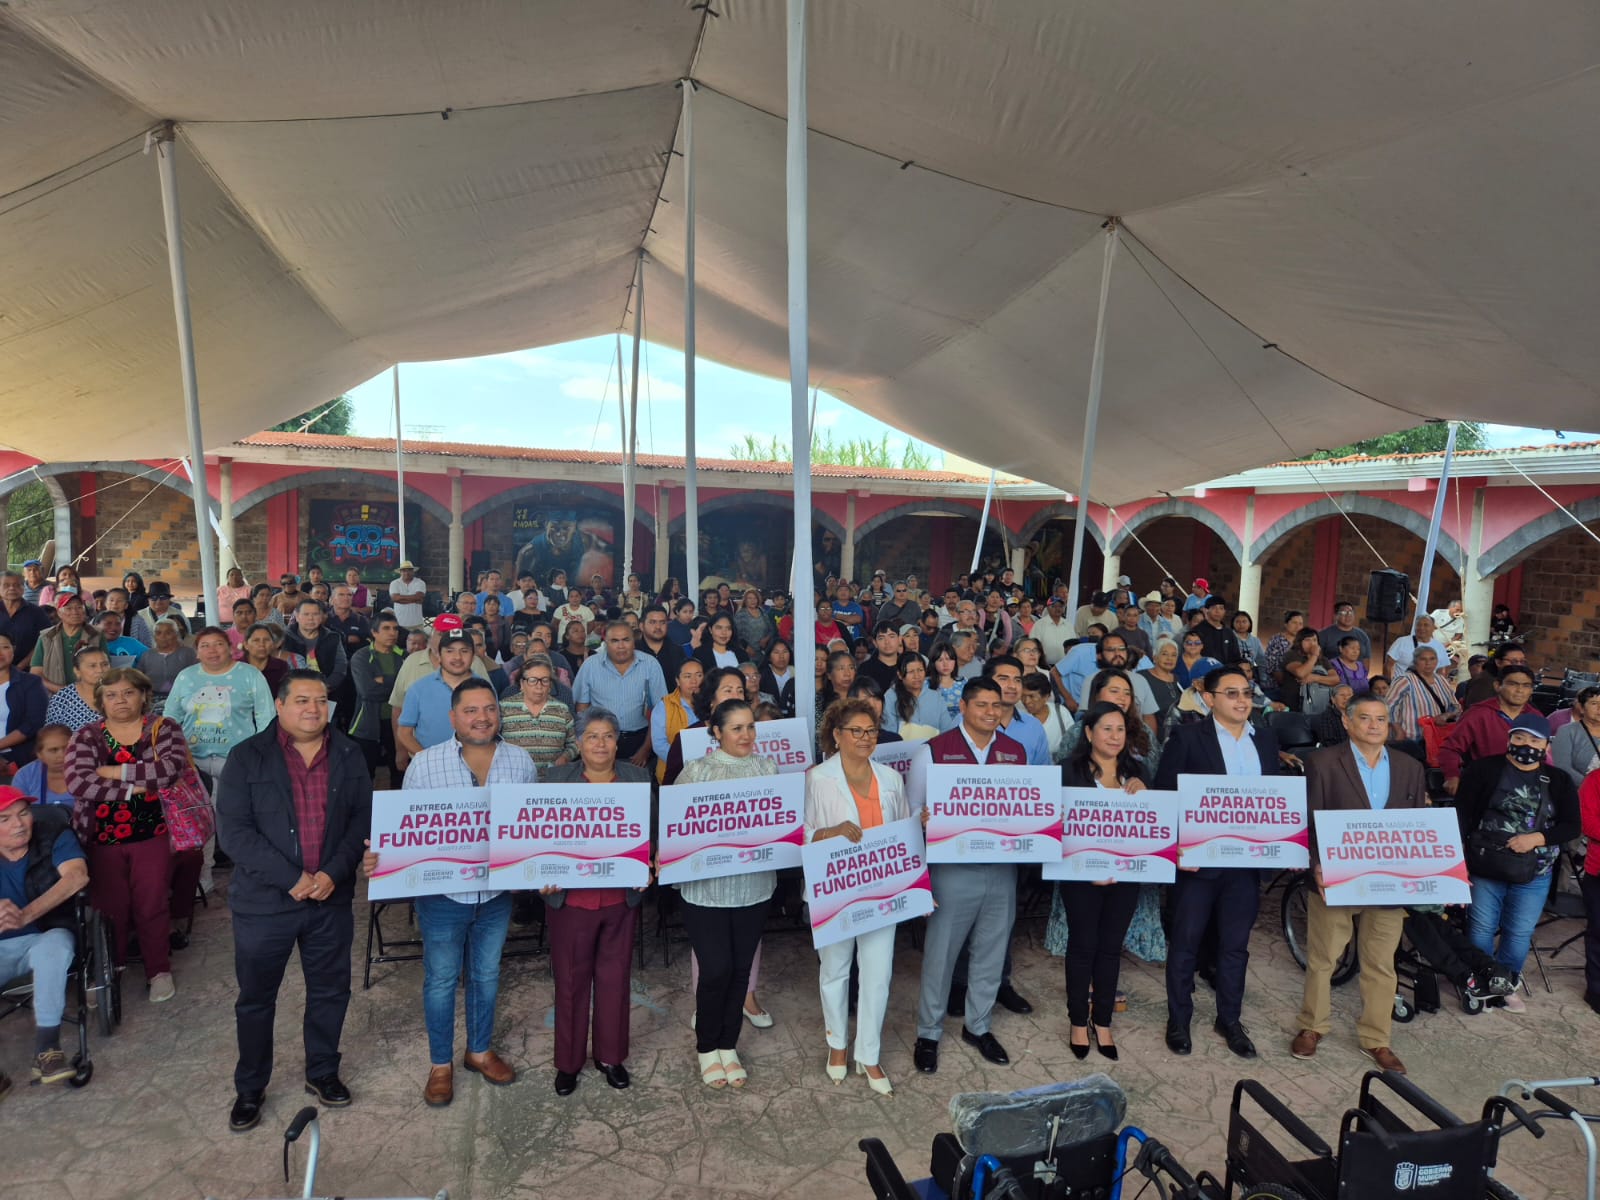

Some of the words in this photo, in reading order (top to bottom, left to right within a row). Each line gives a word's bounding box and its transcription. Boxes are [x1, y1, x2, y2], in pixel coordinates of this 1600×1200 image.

[706, 738, 791, 756] AATOS
[957, 777, 992, 785] ENTREGA
[693, 793, 731, 803] ENTREGA
[733, 789, 762, 799] MASIVA
[763, 788, 775, 796] DE
[949, 786, 1041, 801] APARATOS
[410, 803, 453, 812] ENTREGA
[455, 801, 488, 810] MASIVA
[526, 798, 568, 806] ENTREGA
[570, 797, 602, 805] MASIVA
[684, 796, 783, 820] APARATOS
[1110, 801, 1138, 809] MASIVA
[1199, 795, 1287, 810] APARATOS
[517, 806, 625, 822] APARATOS
[933, 802, 1055, 817] FUNCIONALES
[1067, 808, 1157, 824] APARATOS
[399, 810, 491, 830] APARAT
[667, 810, 797, 838] FUNCIONALES
[1185, 810, 1301, 825] FUNCIONALES
[498, 823, 641, 839] FUNCIONALES
[1062, 823, 1171, 840] UNCIONALES
[1346, 822, 1384, 830] ENTREGA
[379, 827, 490, 848] FUNCIONA
[1342, 829, 1438, 845] APARATOS
[830, 846, 863, 859] ENTREGA
[863, 838, 888, 850] MASIVA
[888, 835, 898, 844] DE
[1014, 839, 1034, 851] DIF
[1262, 845, 1280, 857] DIF
[1327, 845, 1456, 860] FUNCIONALES
[752, 848, 774, 861] DIF
[826, 842, 907, 878] APARATOS
[593, 862, 615, 875] DIF
[1129, 859, 1148, 871] DIF
[813, 855, 922, 898] FUNCIONALES
[1416, 880, 1438, 893] DIF
[889, 896, 908, 912] DIF
